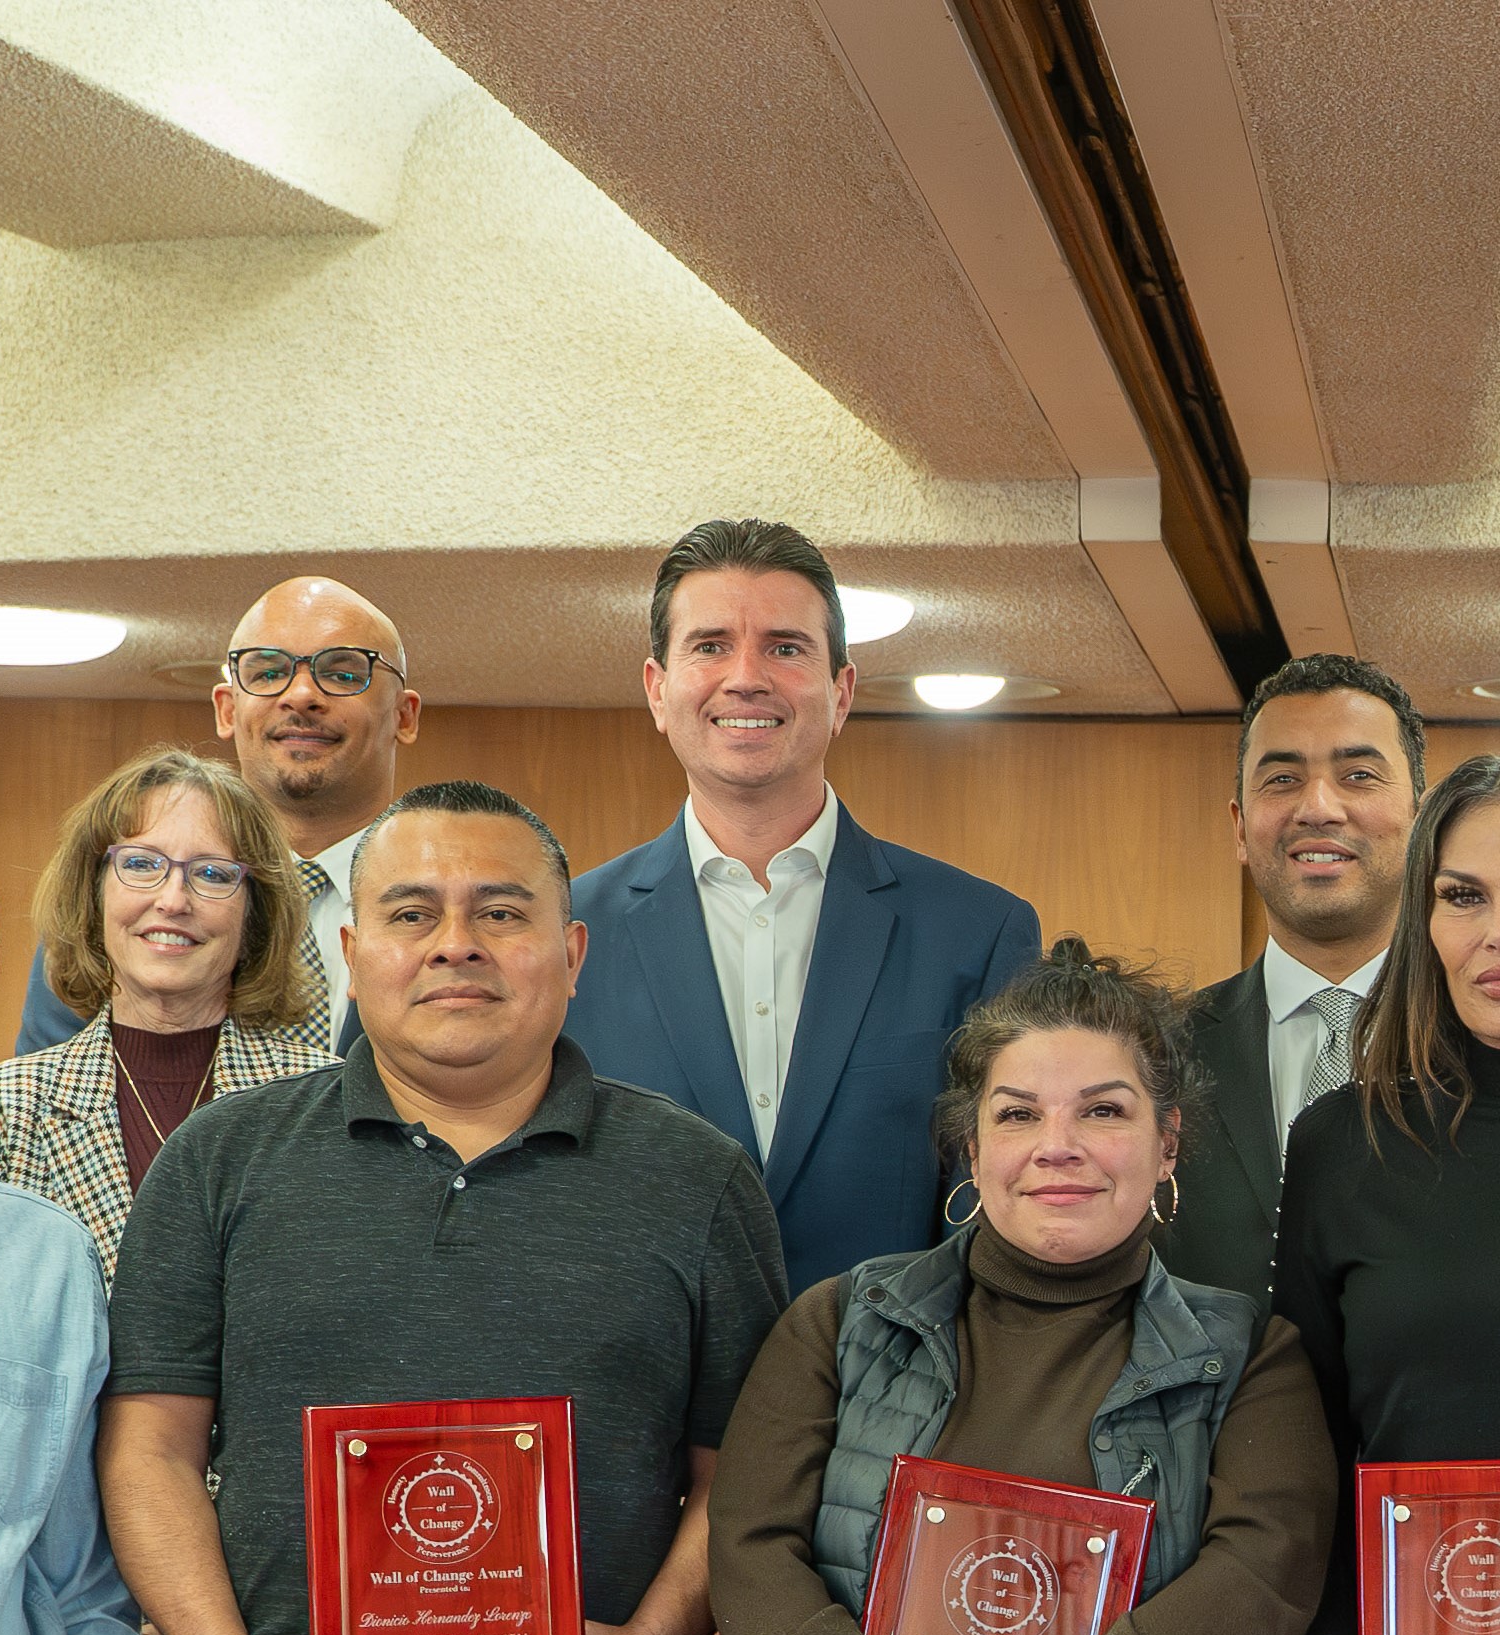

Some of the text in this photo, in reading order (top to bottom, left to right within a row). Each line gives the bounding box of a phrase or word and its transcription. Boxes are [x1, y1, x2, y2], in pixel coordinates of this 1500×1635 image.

[388, 1475, 407, 1504] Honesty
[463, 1461, 494, 1504] Commitment
[427, 1486, 455, 1497] Wall
[436, 1502, 446, 1512] of
[420, 1519, 464, 1531] Change
[416, 1545, 470, 1558] Perseverance
[1430, 1543, 1449, 1572] Honesty
[951, 1551, 975, 1578] Honesty
[1468, 1554, 1495, 1565] Wall
[370, 1566, 523, 1584] Wall of Change Award
[992, 1569, 1019, 1584] Wall
[1032, 1552, 1053, 1601] Commitment
[1476, 1572, 1487, 1581] of
[420, 1585, 458, 1594] Presented
[996, 1589, 1007, 1598] of
[412, 1606, 481, 1629] Hernandez
[483, 1606, 532, 1627] Lorenzo
[976, 1600, 1020, 1620] Change
